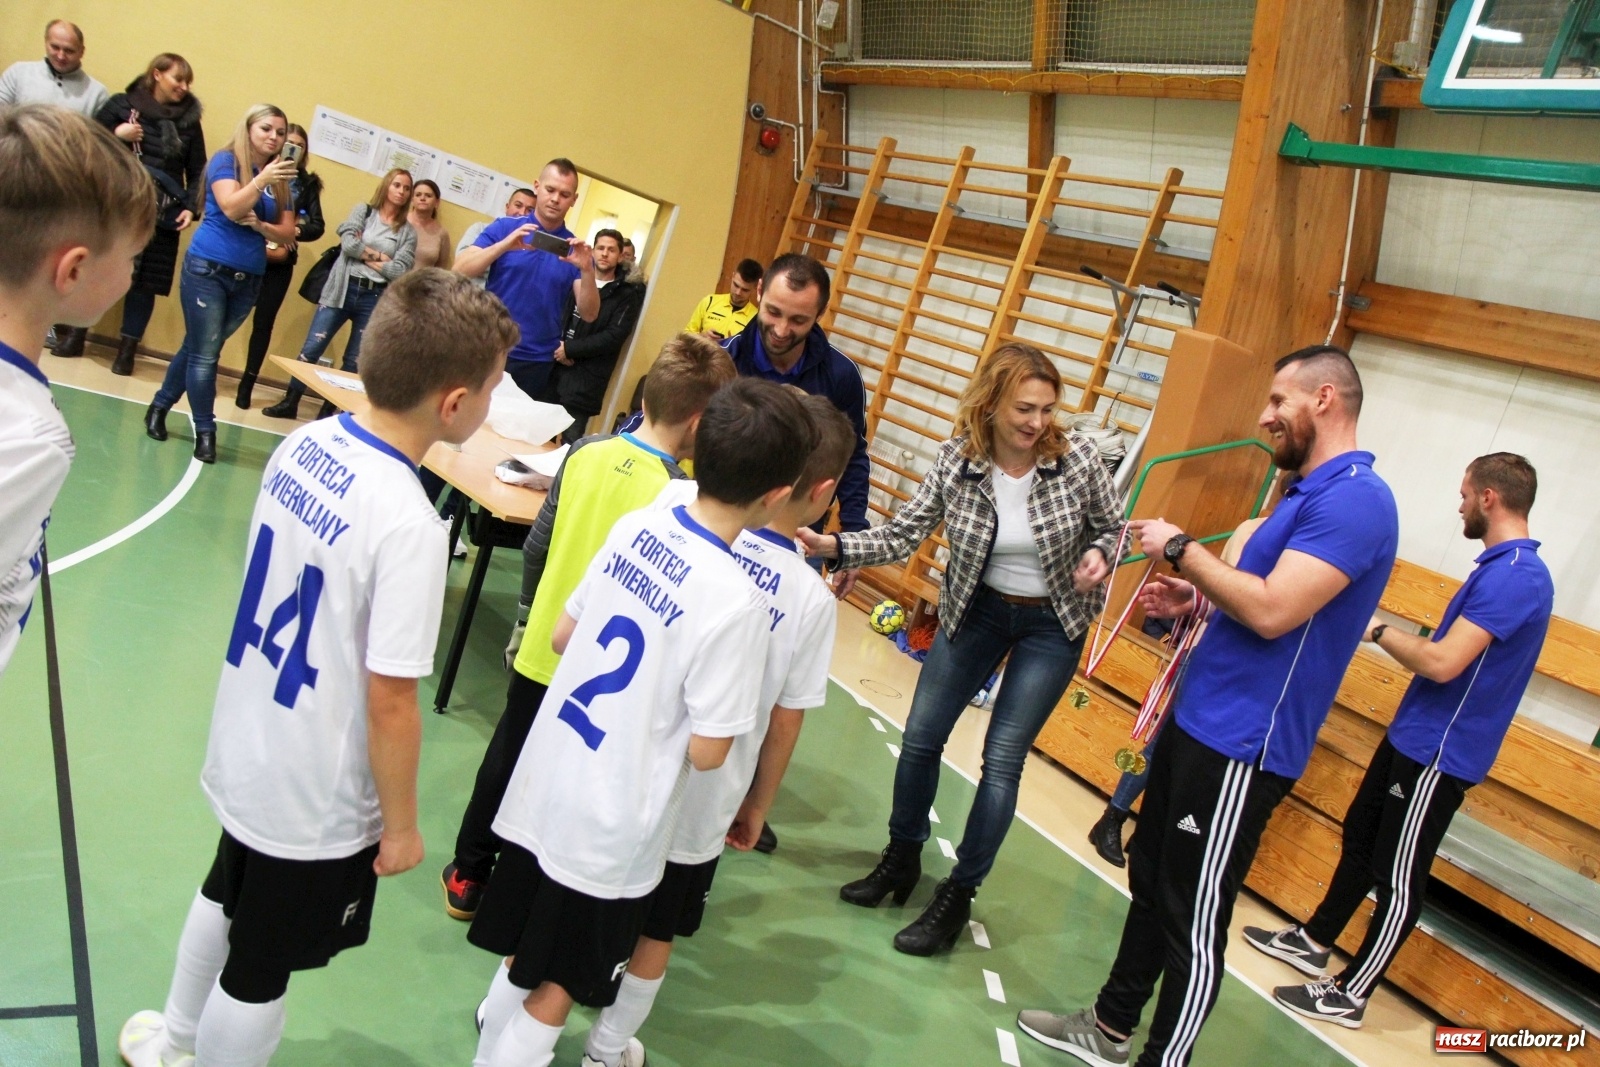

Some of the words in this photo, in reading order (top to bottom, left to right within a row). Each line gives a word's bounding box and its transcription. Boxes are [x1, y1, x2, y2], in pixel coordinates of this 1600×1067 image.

[290, 435, 356, 500] FORTECA
[264, 467, 350, 547] WIERKLANY
[630, 528, 692, 588] FORTECA
[742, 540, 765, 554] 1967
[557, 614, 646, 752] 2
[1177, 822, 1201, 835] adidas
